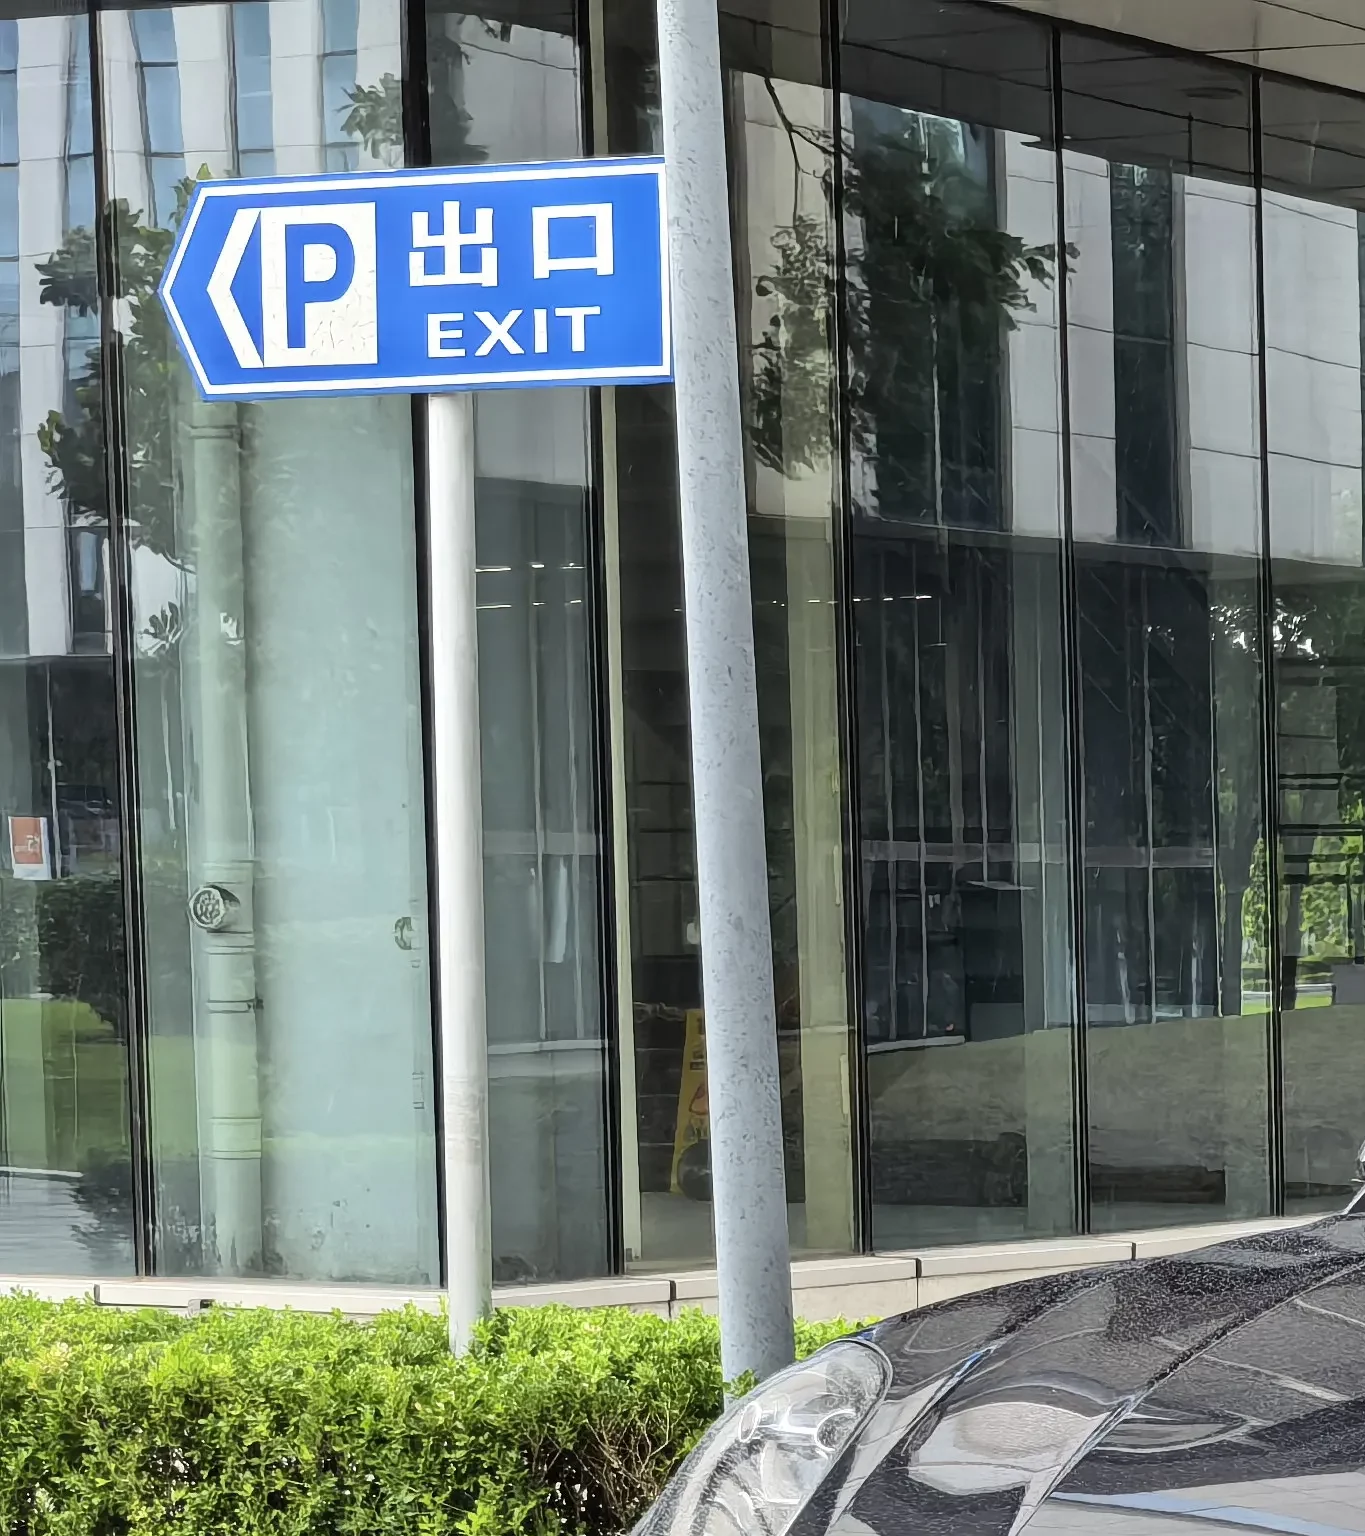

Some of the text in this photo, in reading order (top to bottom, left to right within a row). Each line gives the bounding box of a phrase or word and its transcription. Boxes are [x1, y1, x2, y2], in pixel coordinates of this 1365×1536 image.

[284, 223, 355, 348] P
[408, 201, 615, 288] 出口
[427, 306, 601, 359] EXIT
